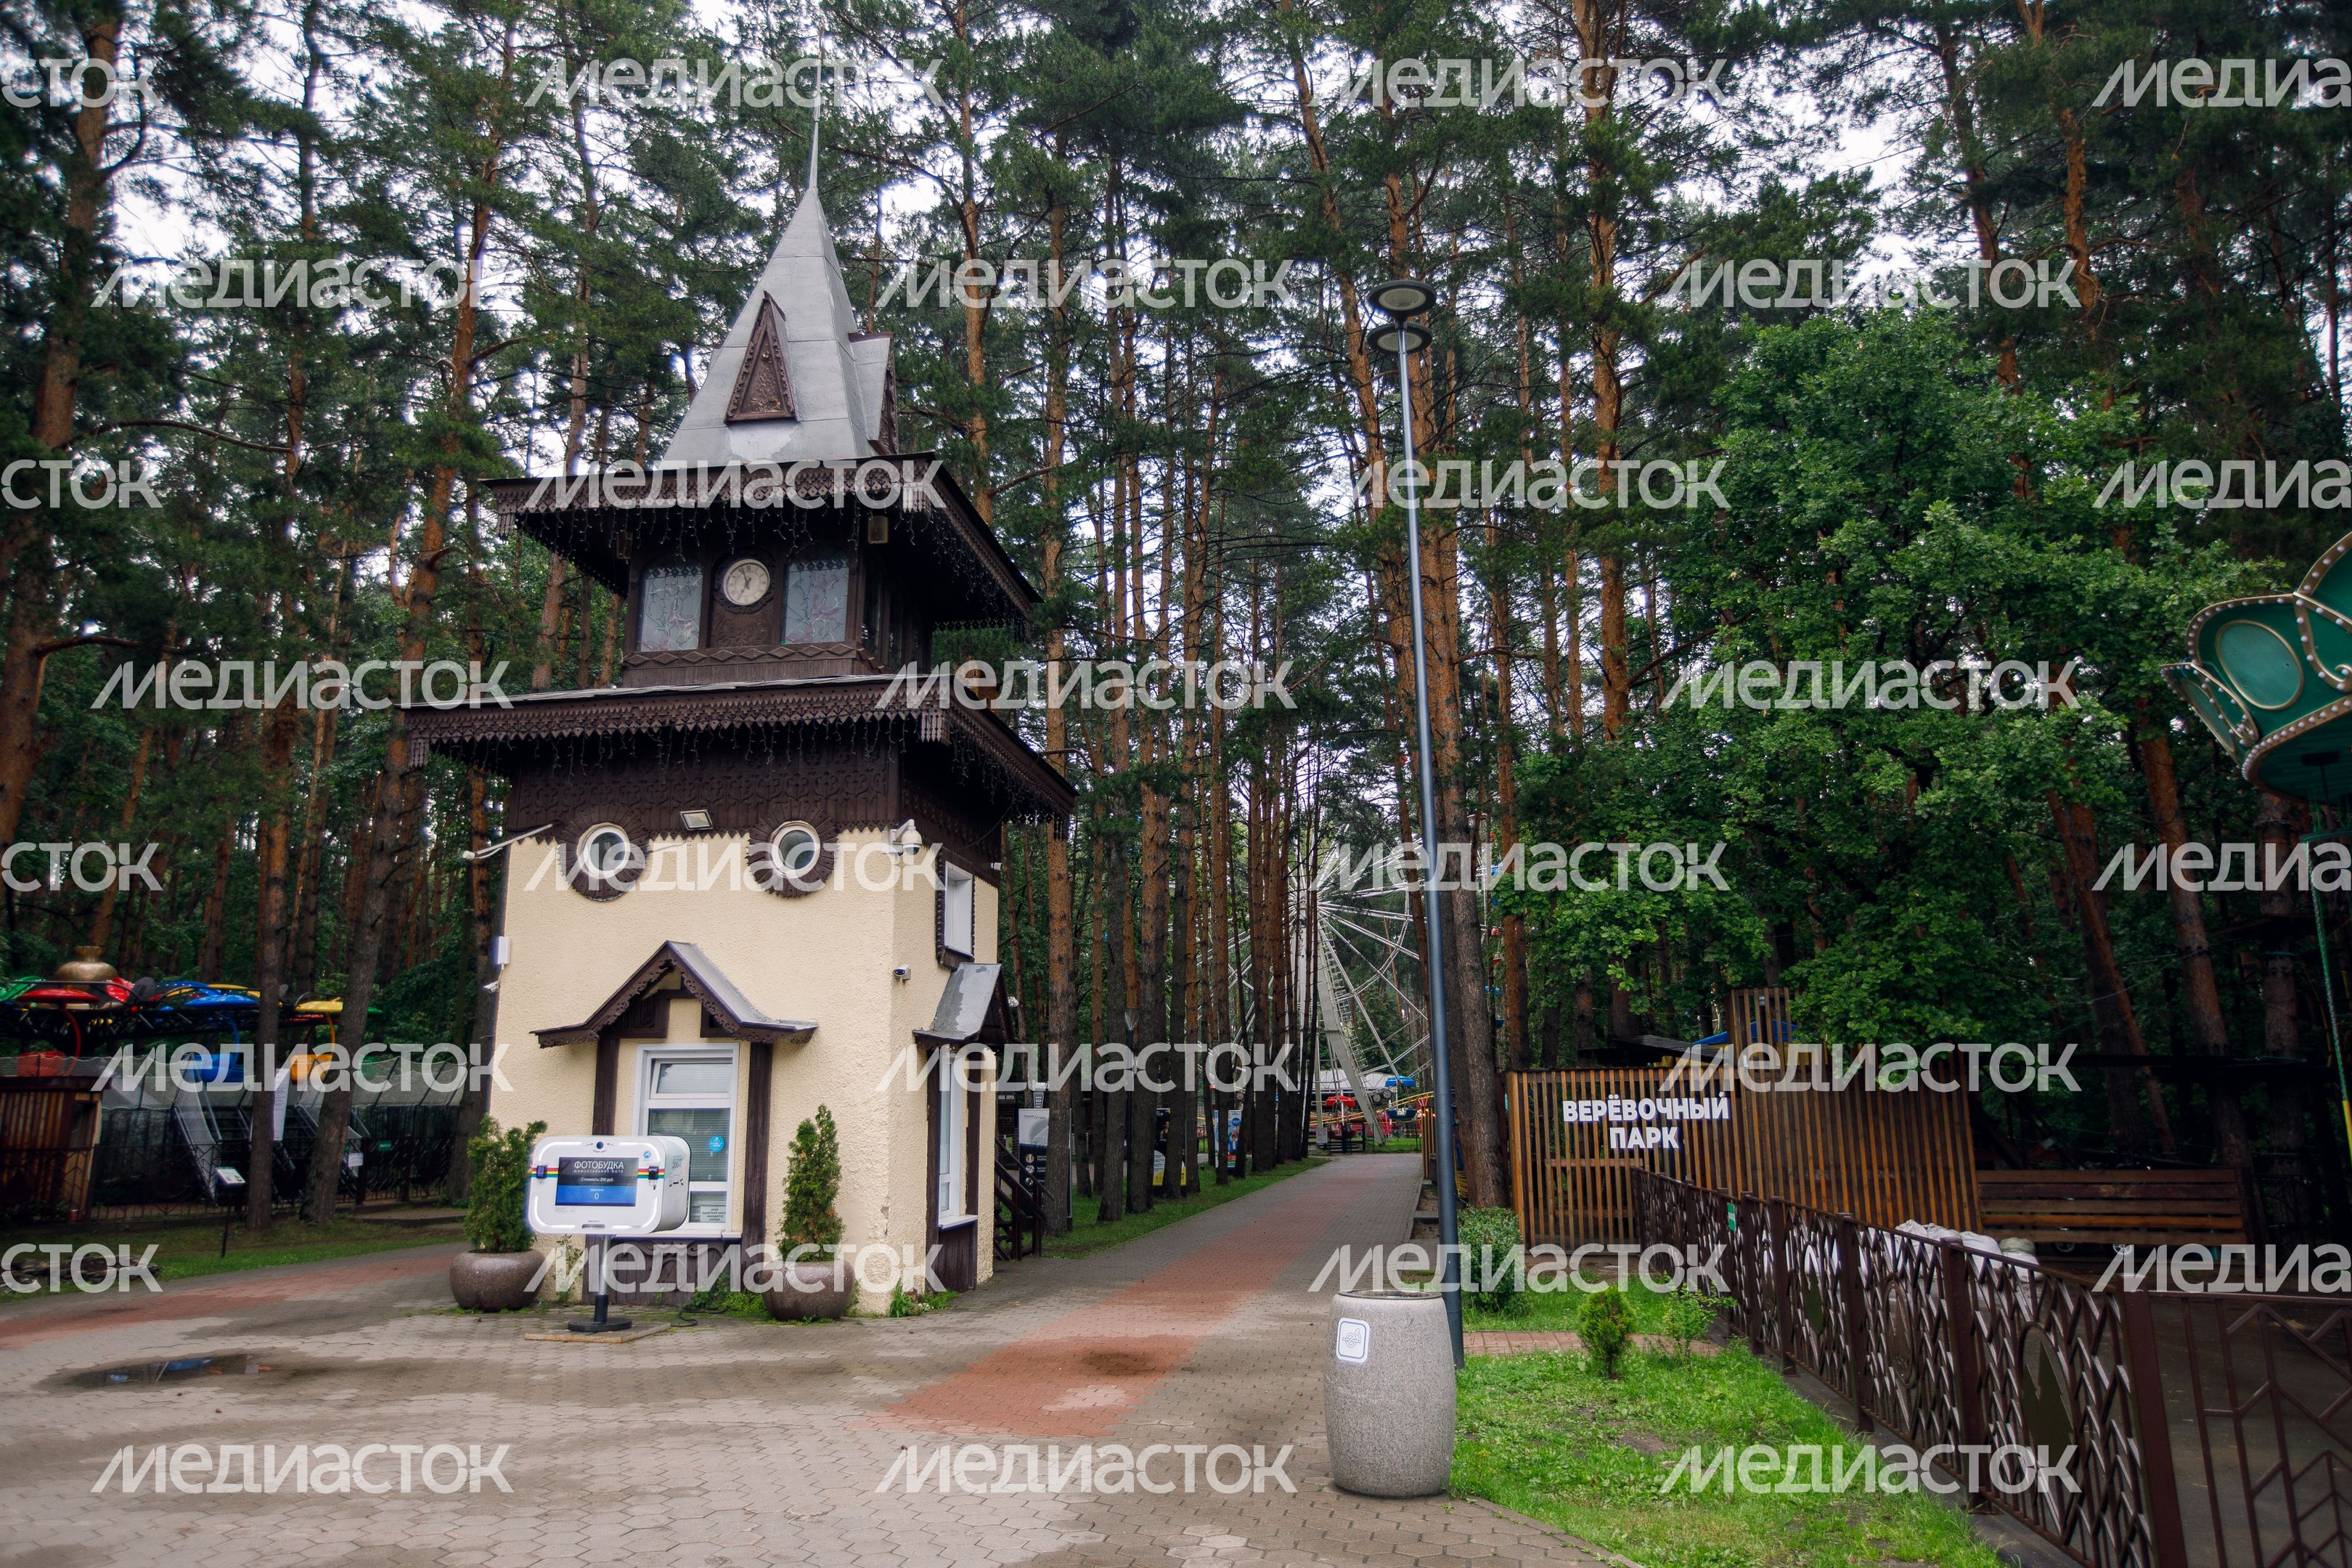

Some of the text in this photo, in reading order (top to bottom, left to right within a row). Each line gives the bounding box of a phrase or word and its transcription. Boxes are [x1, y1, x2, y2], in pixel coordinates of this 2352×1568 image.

[1563, 1092, 1728, 1122] ВЕРЁВОЧНЫЙ
[1609, 1127, 1679, 1148] ПАРК
[574, 1160, 624, 1170] ФОТОБУДКА
